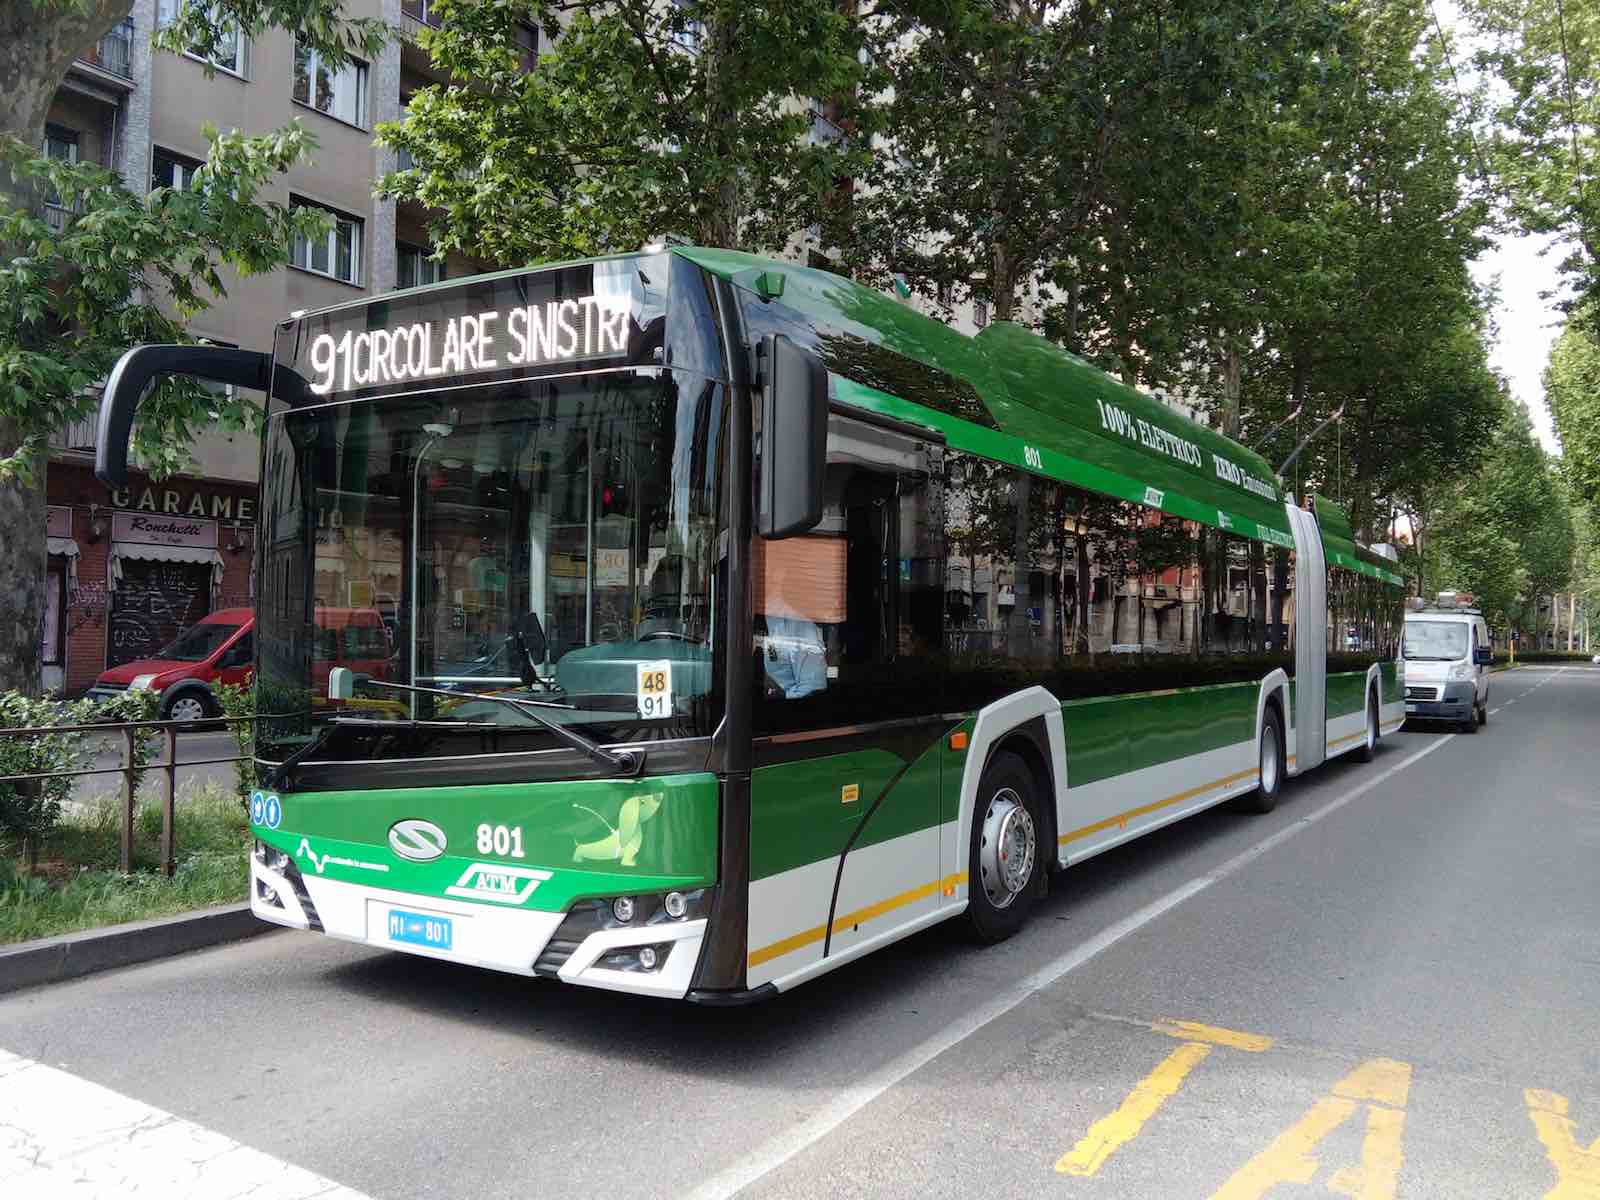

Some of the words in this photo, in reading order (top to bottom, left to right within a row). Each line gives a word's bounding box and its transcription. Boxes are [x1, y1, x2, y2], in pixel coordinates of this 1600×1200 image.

[309, 330, 352, 394] 91
[353, 312, 498, 383] CIRCOLARE
[1096, 399, 1137, 441] 100%
[1137, 419, 1202, 467] ELETTRICO
[1213, 454, 1241, 485] ZERO
[1024, 445, 1042, 469] 801
[643, 672, 665, 693] 48
[644, 696, 664, 716] 91
[476, 823, 525, 858] 801
[476, 872, 517, 893] ATM
[426, 920, 449, 944] 801
